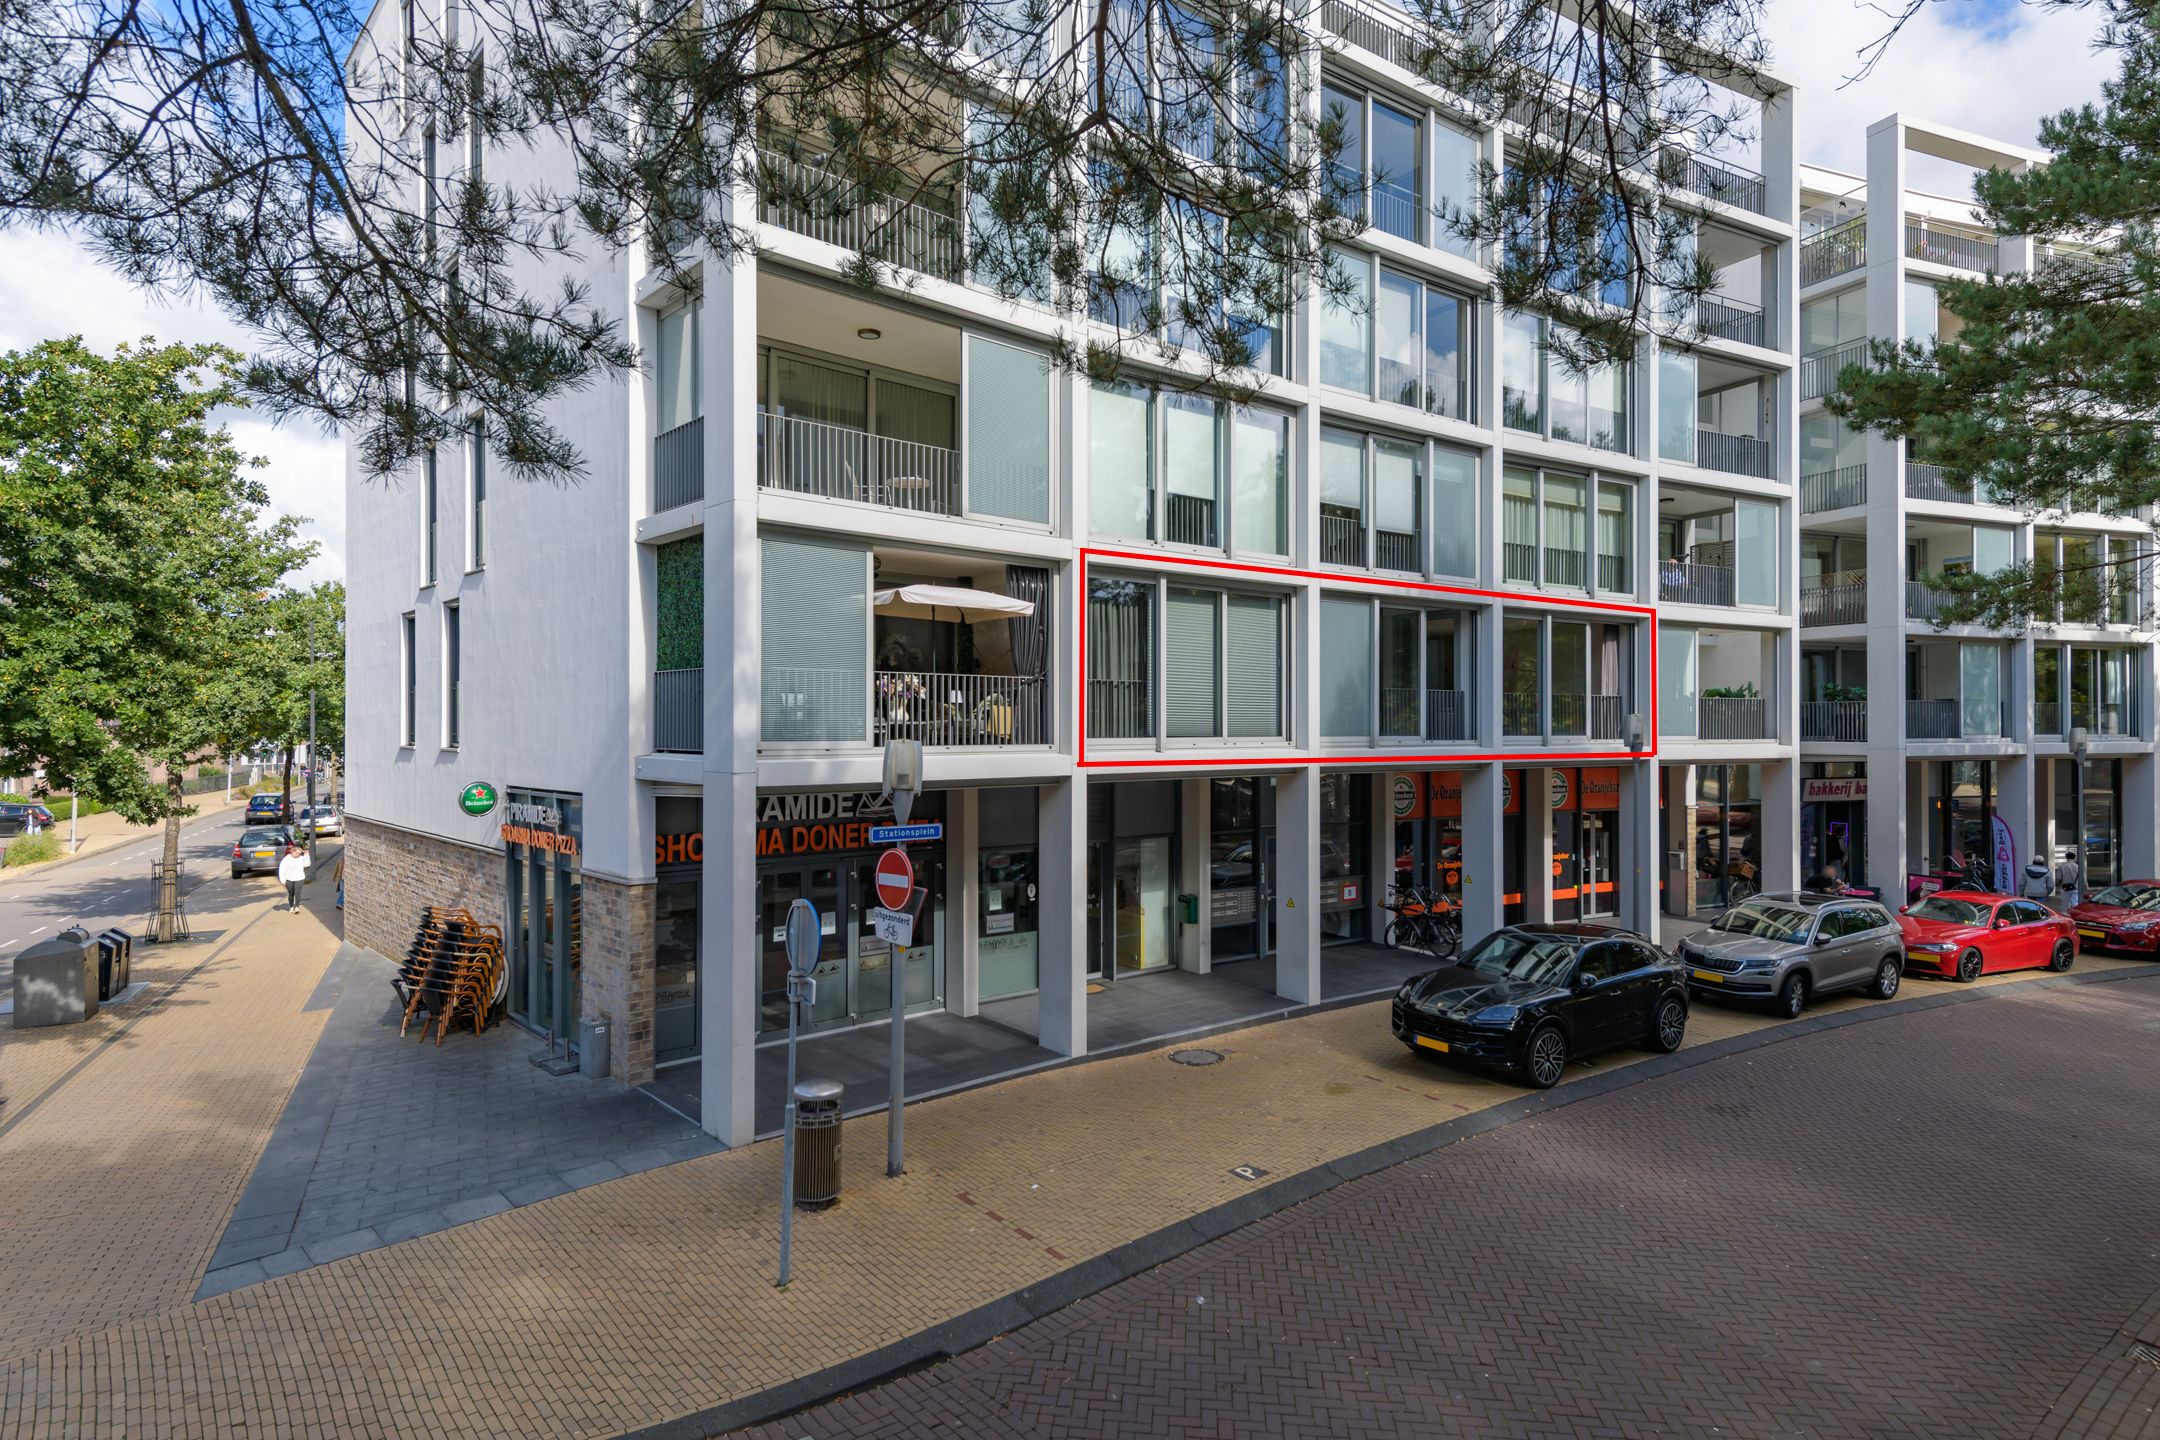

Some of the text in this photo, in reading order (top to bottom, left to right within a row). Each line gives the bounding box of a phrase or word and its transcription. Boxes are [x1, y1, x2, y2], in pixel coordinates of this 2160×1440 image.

[1432, 786, 1462, 802] De Oranje
[1809, 781, 1868, 798] bakkerij ba
[510, 802, 547, 825] PIRAMIDE
[878, 828, 935, 838] Stationsplein
[531, 829, 555, 851] DONER
[555, 833, 577, 856] PIZZA
[875, 910, 910, 926] uitgezonderd
